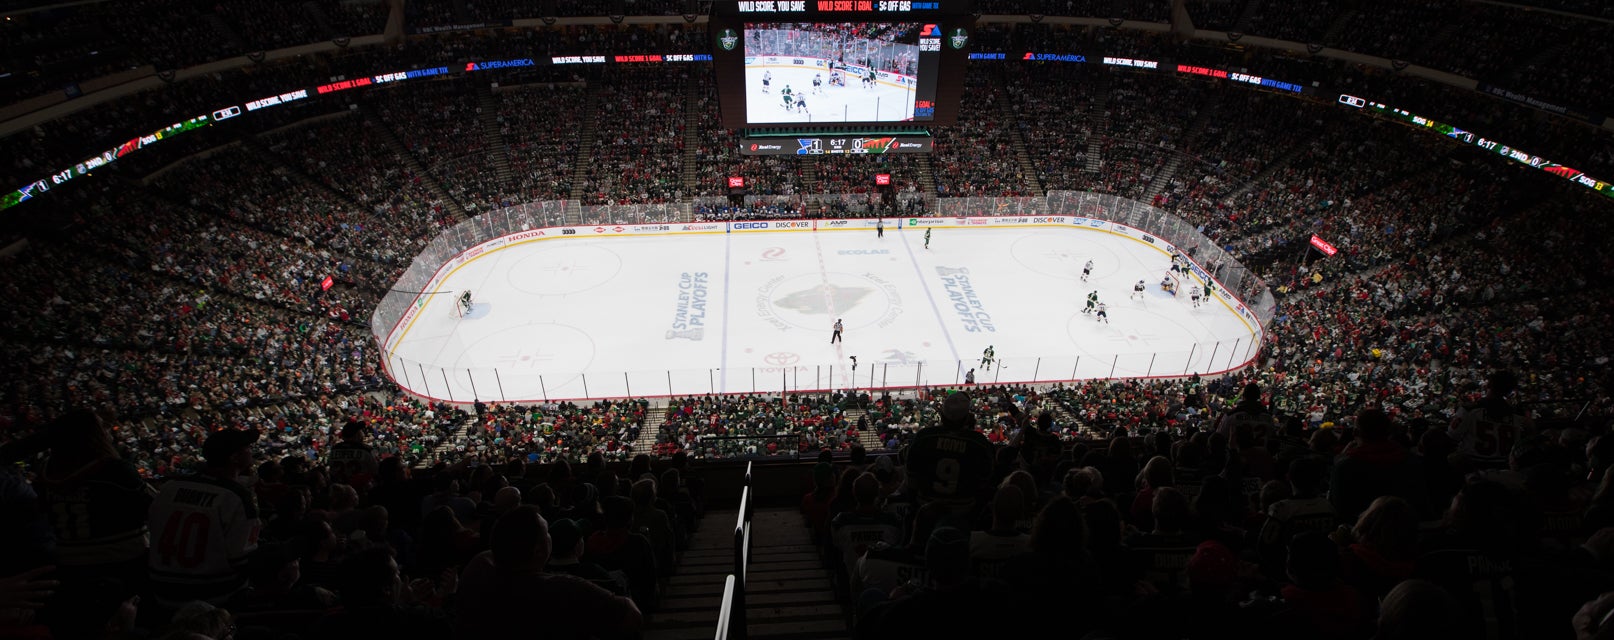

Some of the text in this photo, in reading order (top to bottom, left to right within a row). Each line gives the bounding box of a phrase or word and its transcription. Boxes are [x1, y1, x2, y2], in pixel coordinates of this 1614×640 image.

[738, 1, 806, 12] WILD SCORE, YOU SAVE
[818, 0, 834, 12] WILD
[834, 0, 853, 11] SCORE
[854, 1, 858, 10] 1
[858, 1, 872, 11] GOAL
[888, 1, 899, 12] OFF
[900, 1, 911, 12] GAS
[480, 58, 535, 70] SUPERAMERICA
[1036, 54, 1087, 63] SUPERAMERICA
[1526, 96, 1567, 114] Management
[1478, 138, 1498, 150] 6:17
[1510, 150, 1528, 161] 2ND
[52, 169, 72, 184] 6:17
[1578, 176, 1597, 188] SOG
[508, 230, 545, 242] HONDA
[672, 272, 692, 330] STANLEY CUP
[690, 272, 708, 326] PLAYOFFS
[940, 277, 982, 332] PLAYOFFS
[954, 274, 996, 332] STANLEY CUP
[933, 458, 960, 494] 9
[159, 511, 210, 568] 40
